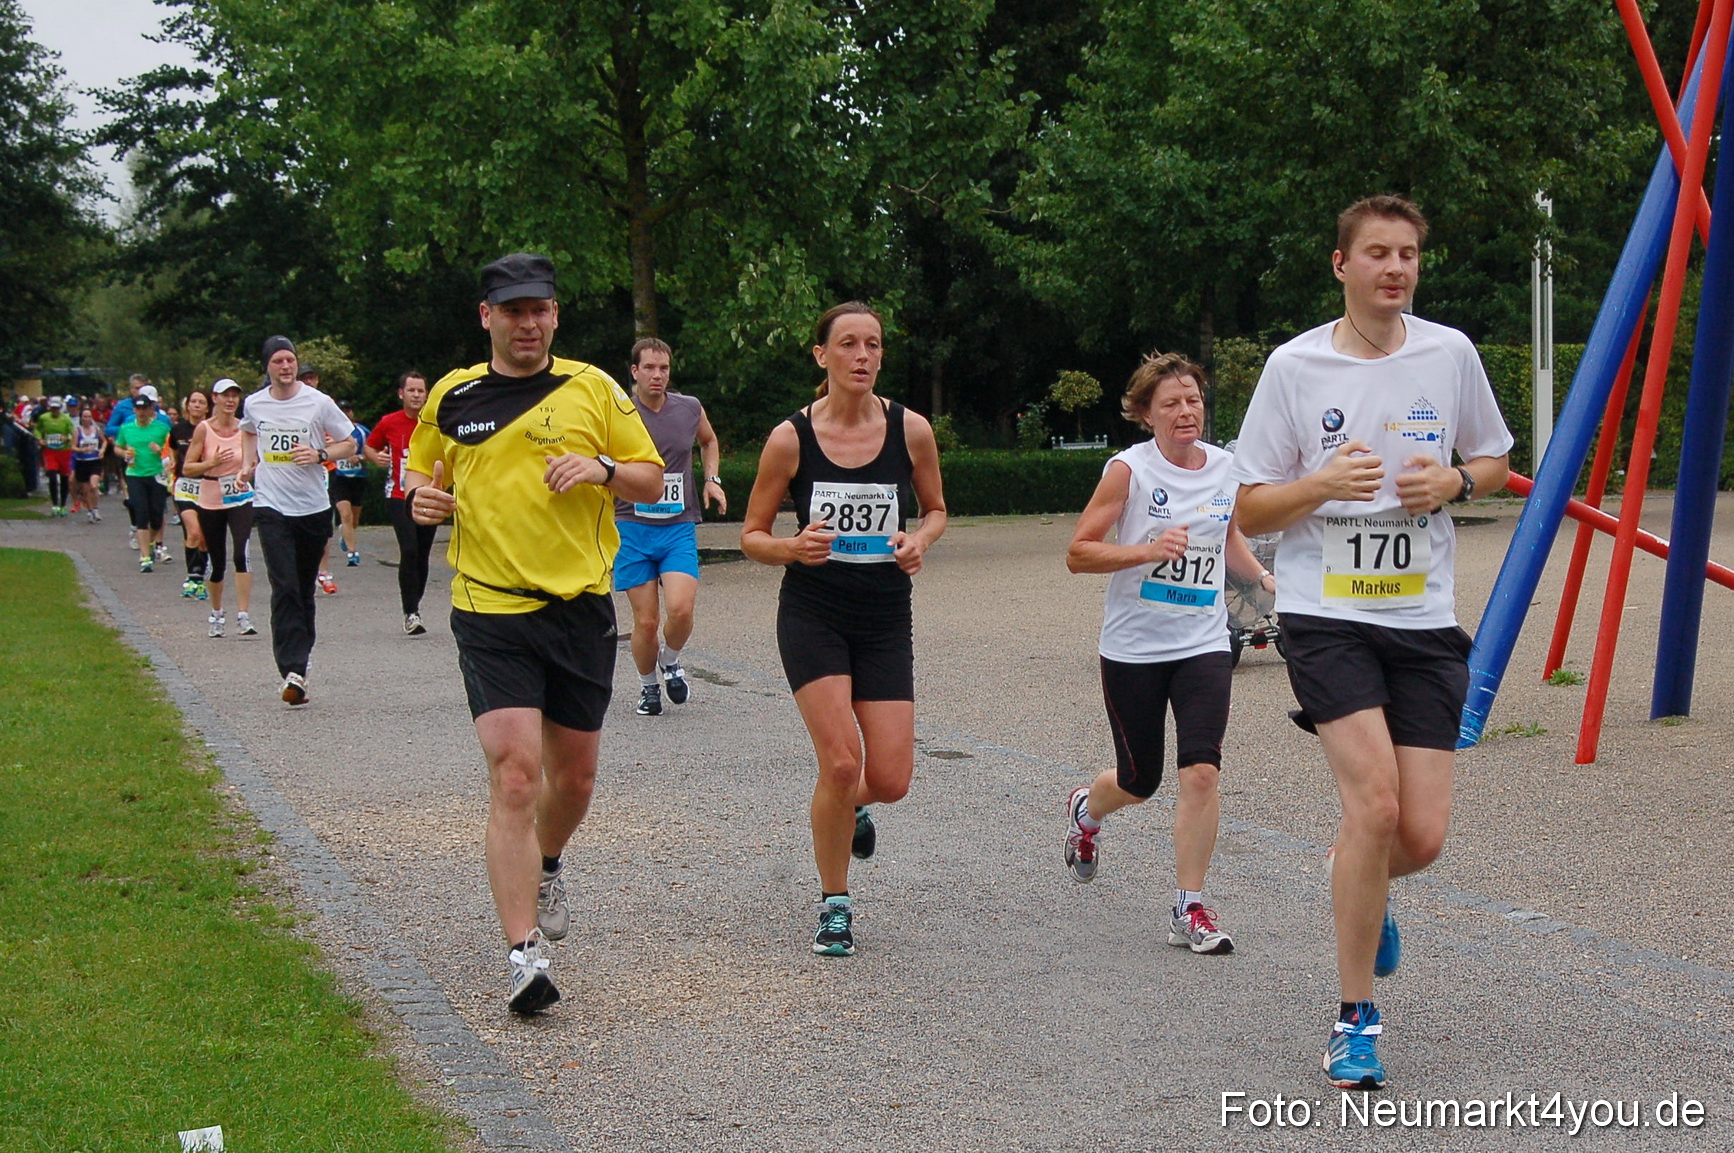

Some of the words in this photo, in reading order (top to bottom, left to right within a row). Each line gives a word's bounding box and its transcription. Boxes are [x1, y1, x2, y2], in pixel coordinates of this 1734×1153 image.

[458, 420, 496, 437] Robert
[270, 434, 300, 451] 268
[524, 430, 566, 445] Burgthann
[1321, 433, 1349, 445] PARTL
[181, 482, 200, 494] 381
[664, 484, 680, 501] 18
[814, 490, 843, 499] PARTL
[844, 492, 885, 500] Neumarkt
[819, 502, 891, 532] 2837
[1148, 505, 1171, 515] PARTL
[1326, 517, 1361, 527] PARTL
[1364, 518, 1414, 528] Neumarkt
[838, 539, 868, 552] Petra
[1187, 545, 1214, 553] umarkt
[1346, 532, 1411, 570] 170
[1151, 555, 1216, 585] 2912
[1351, 579, 1401, 595] Markus
[1166, 588, 1198, 604] Maria
